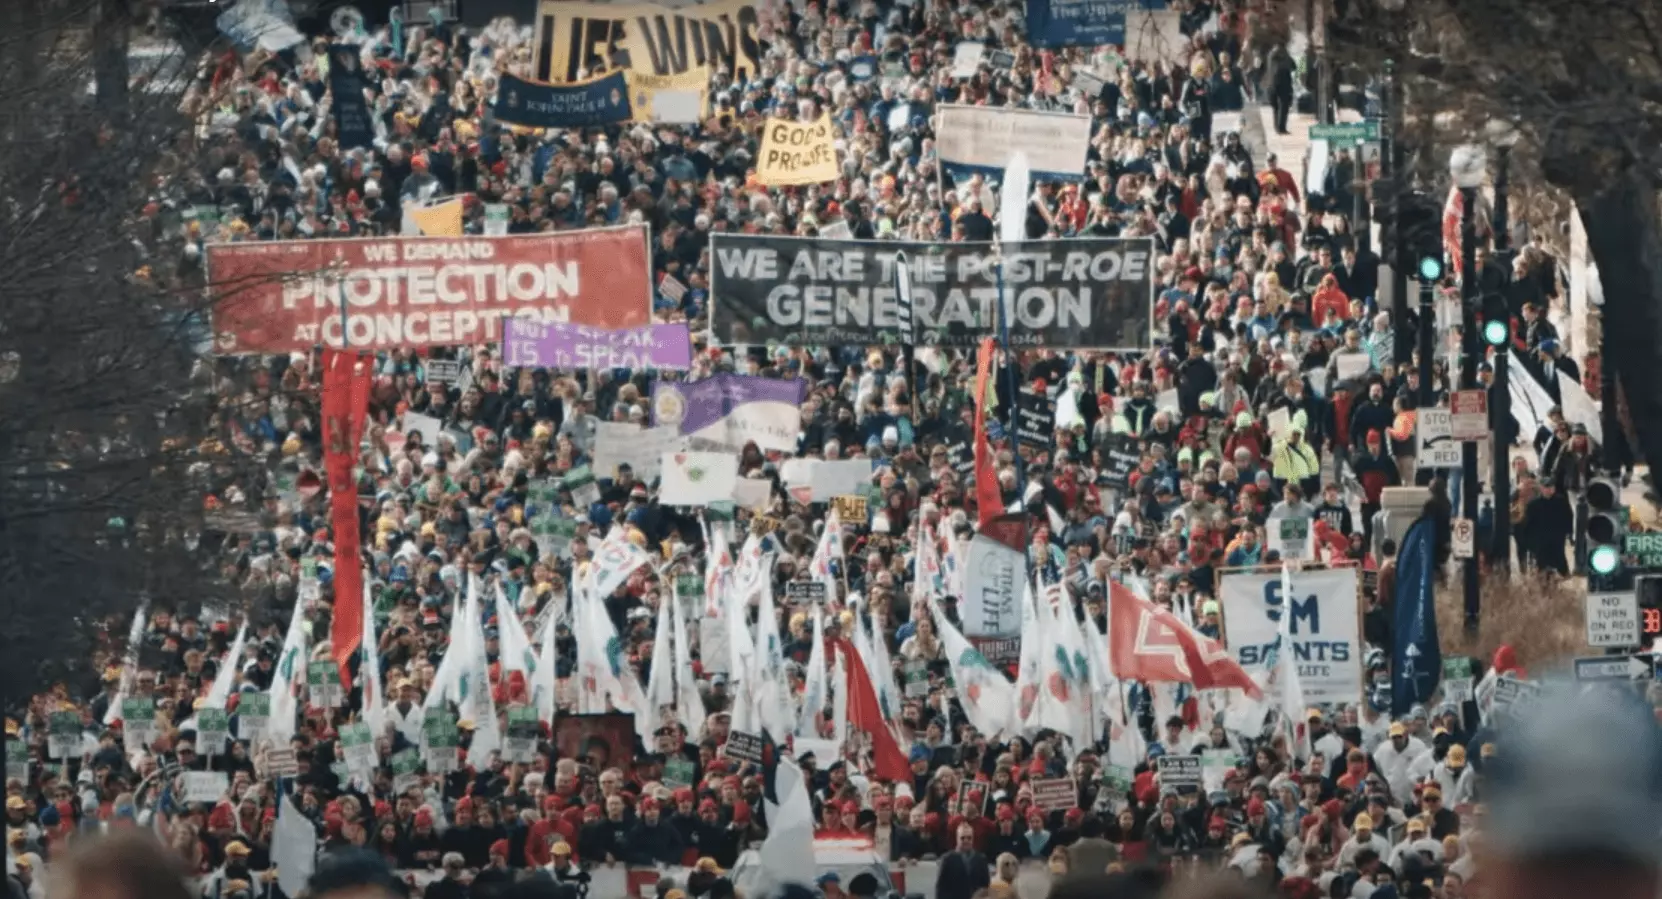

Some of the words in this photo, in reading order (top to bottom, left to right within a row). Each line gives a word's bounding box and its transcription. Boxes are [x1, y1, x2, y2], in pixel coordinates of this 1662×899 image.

[635, 5, 763, 80] WINS
[363, 243, 398, 261] WE
[403, 239, 495, 260] DEMAND
[717, 247, 778, 280] WE
[787, 249, 866, 281] ARE
[874, 251, 947, 283] THE
[956, 249, 1149, 283] POST-ROE
[281, 259, 580, 309] PROTECTION
[766, 283, 1093, 329] GENERATION
[293, 323, 321, 342] AT
[1434, 451, 1459, 462] RED
[982, 587, 1000, 633] LIFE
[1602, 596, 1620, 607] NO
[1597, 609, 1627, 619] TURN
[1591, 621, 1606, 632] ON
[1612, 620, 1634, 631] RED
[1239, 641, 1350, 666] SANTS
